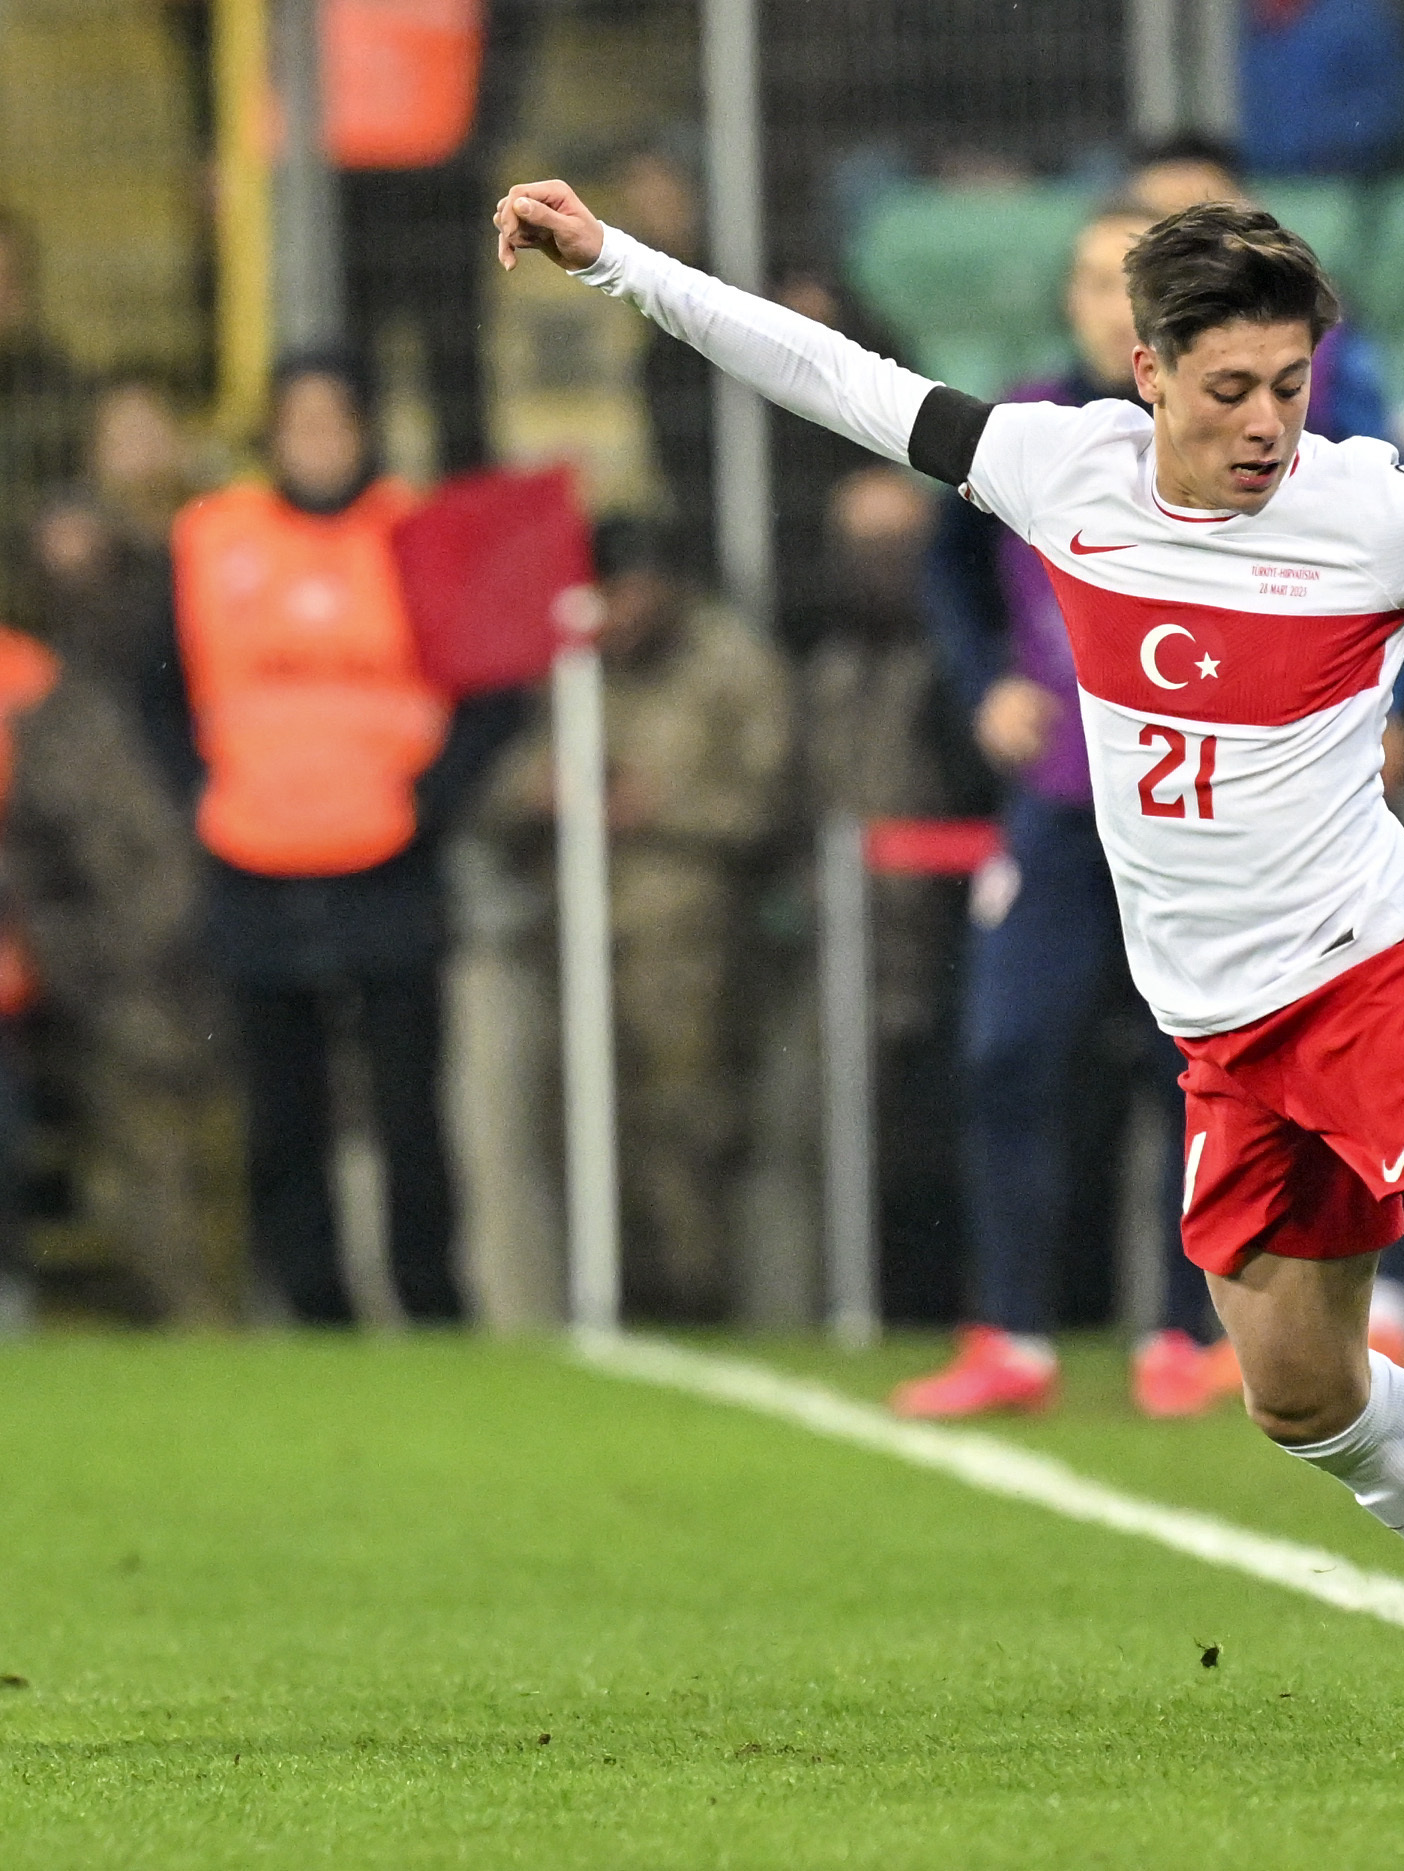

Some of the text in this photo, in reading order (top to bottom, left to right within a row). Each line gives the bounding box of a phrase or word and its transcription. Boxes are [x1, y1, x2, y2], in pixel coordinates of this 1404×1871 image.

[1259, 583, 1268, 594] 28
[1270, 584, 1288, 596] MART
[1138, 723, 1217, 819] 21
